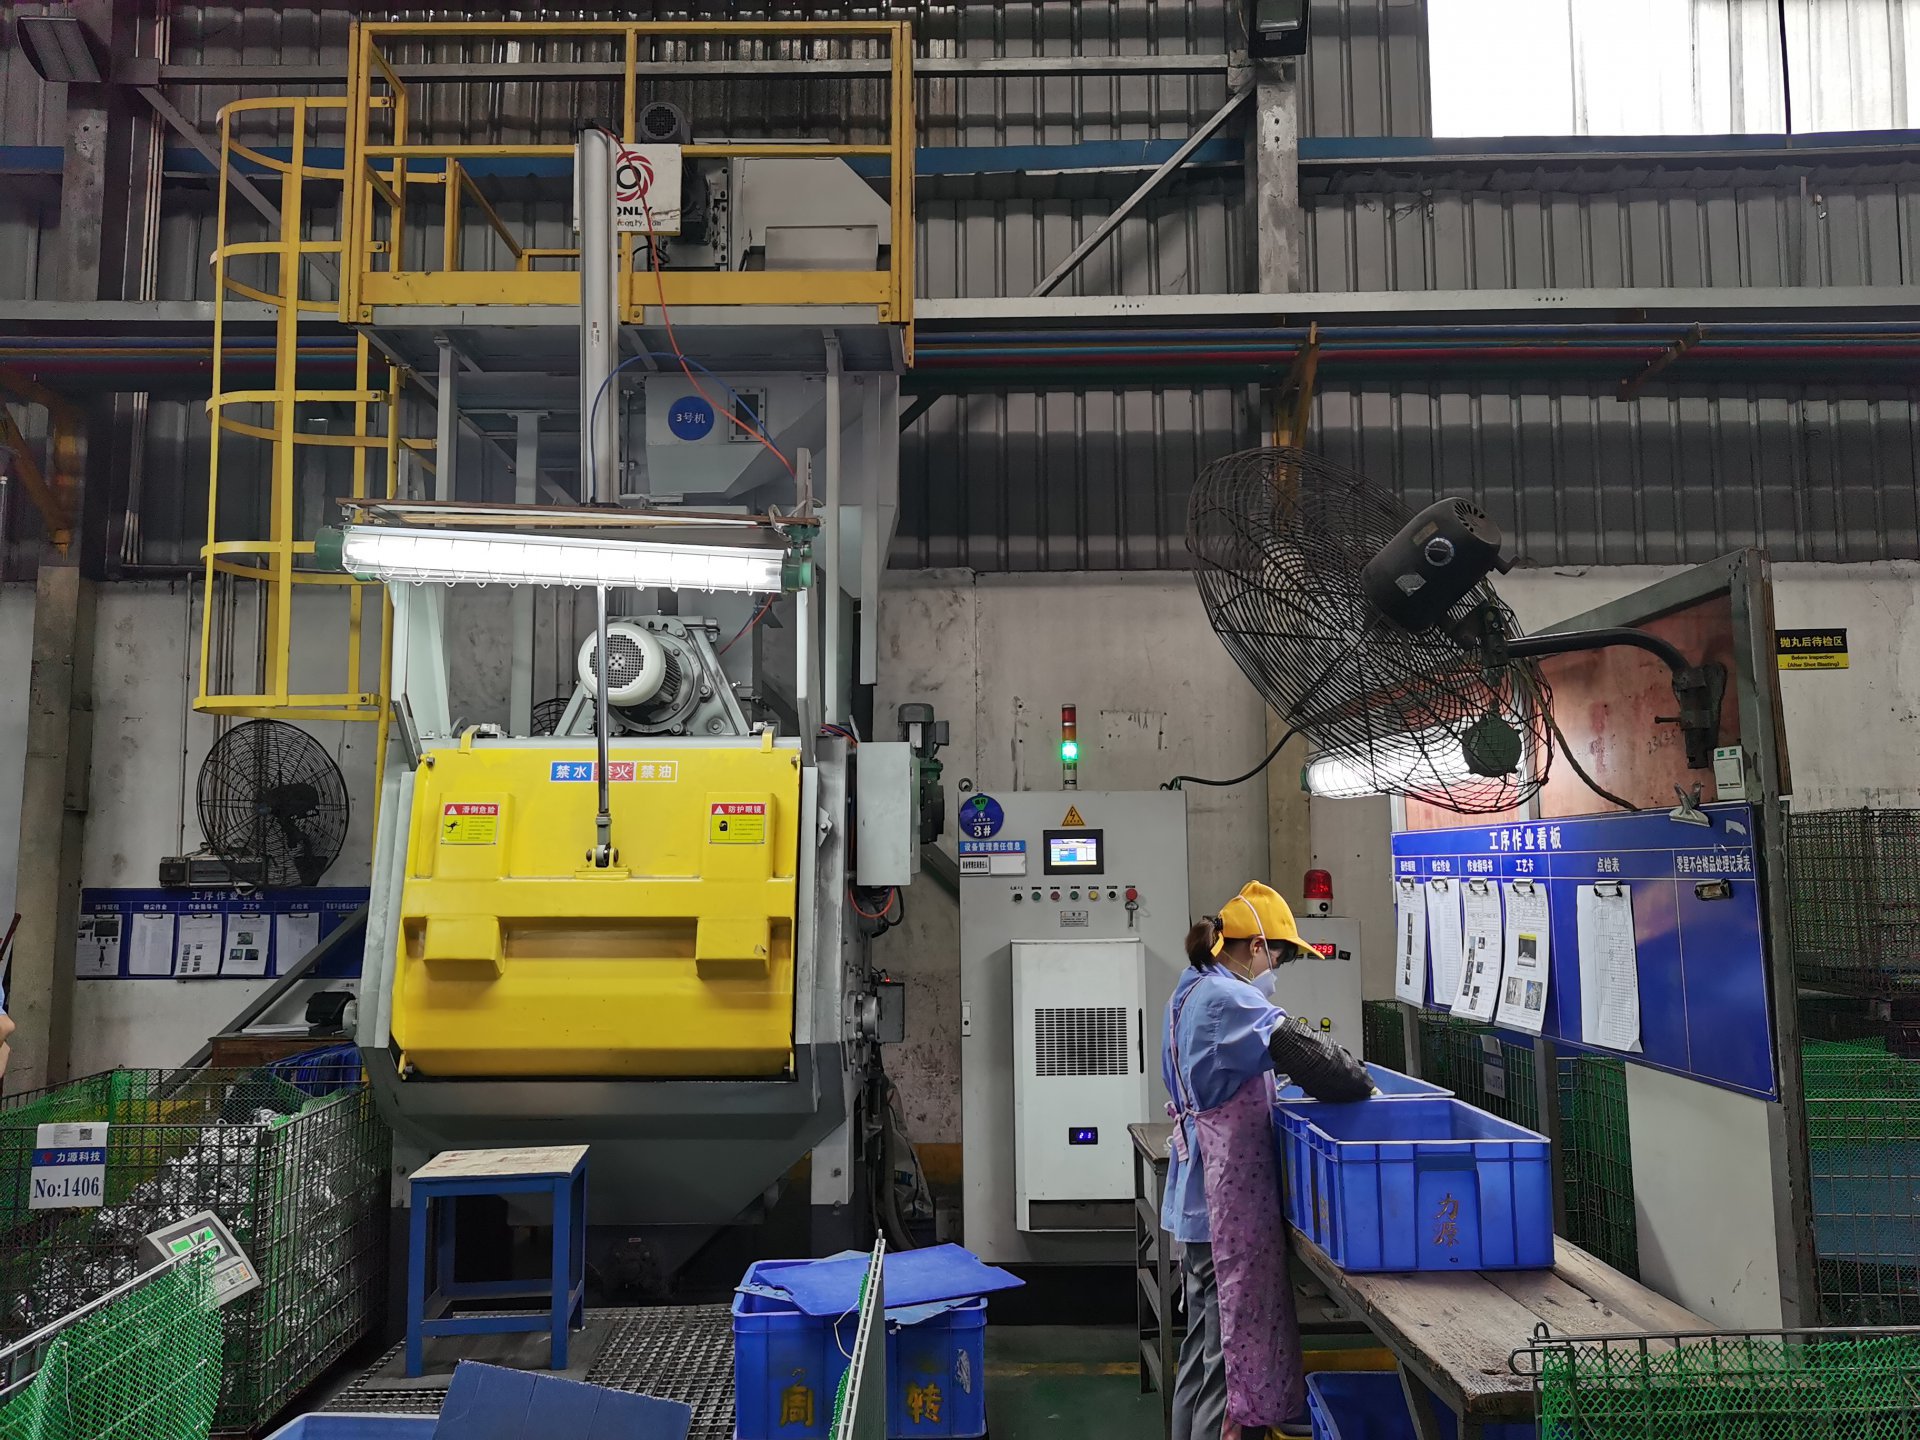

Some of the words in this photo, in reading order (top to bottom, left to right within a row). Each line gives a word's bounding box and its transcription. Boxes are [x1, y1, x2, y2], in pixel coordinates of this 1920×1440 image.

[676, 412, 706, 424] 3号机
[1780, 635, 1844, 648] 抛丸后待检区
[556, 765, 587, 779] 禁水
[641, 765, 672, 779] 禁油
[462, 805, 496, 814] 滑倒危险
[728, 805, 761, 814] 防护眼镜
[974, 825, 991, 837] 3#
[1489, 826, 1563, 851] 工序作业看板
[964, 842, 1021, 852] 设备管理责任信息
[1467, 859, 1494, 873] 作业指导书
[1515, 858, 1534, 873] 工艺卡
[1597, 857, 1620, 873] 点检表
[1676, 854, 1752, 873] 零星不合格品处理记录表
[191, 892, 264, 901] 工序作业板
[56, 1150, 101, 1163] 力源科技
[34, 1176, 99, 1199] No:1406
